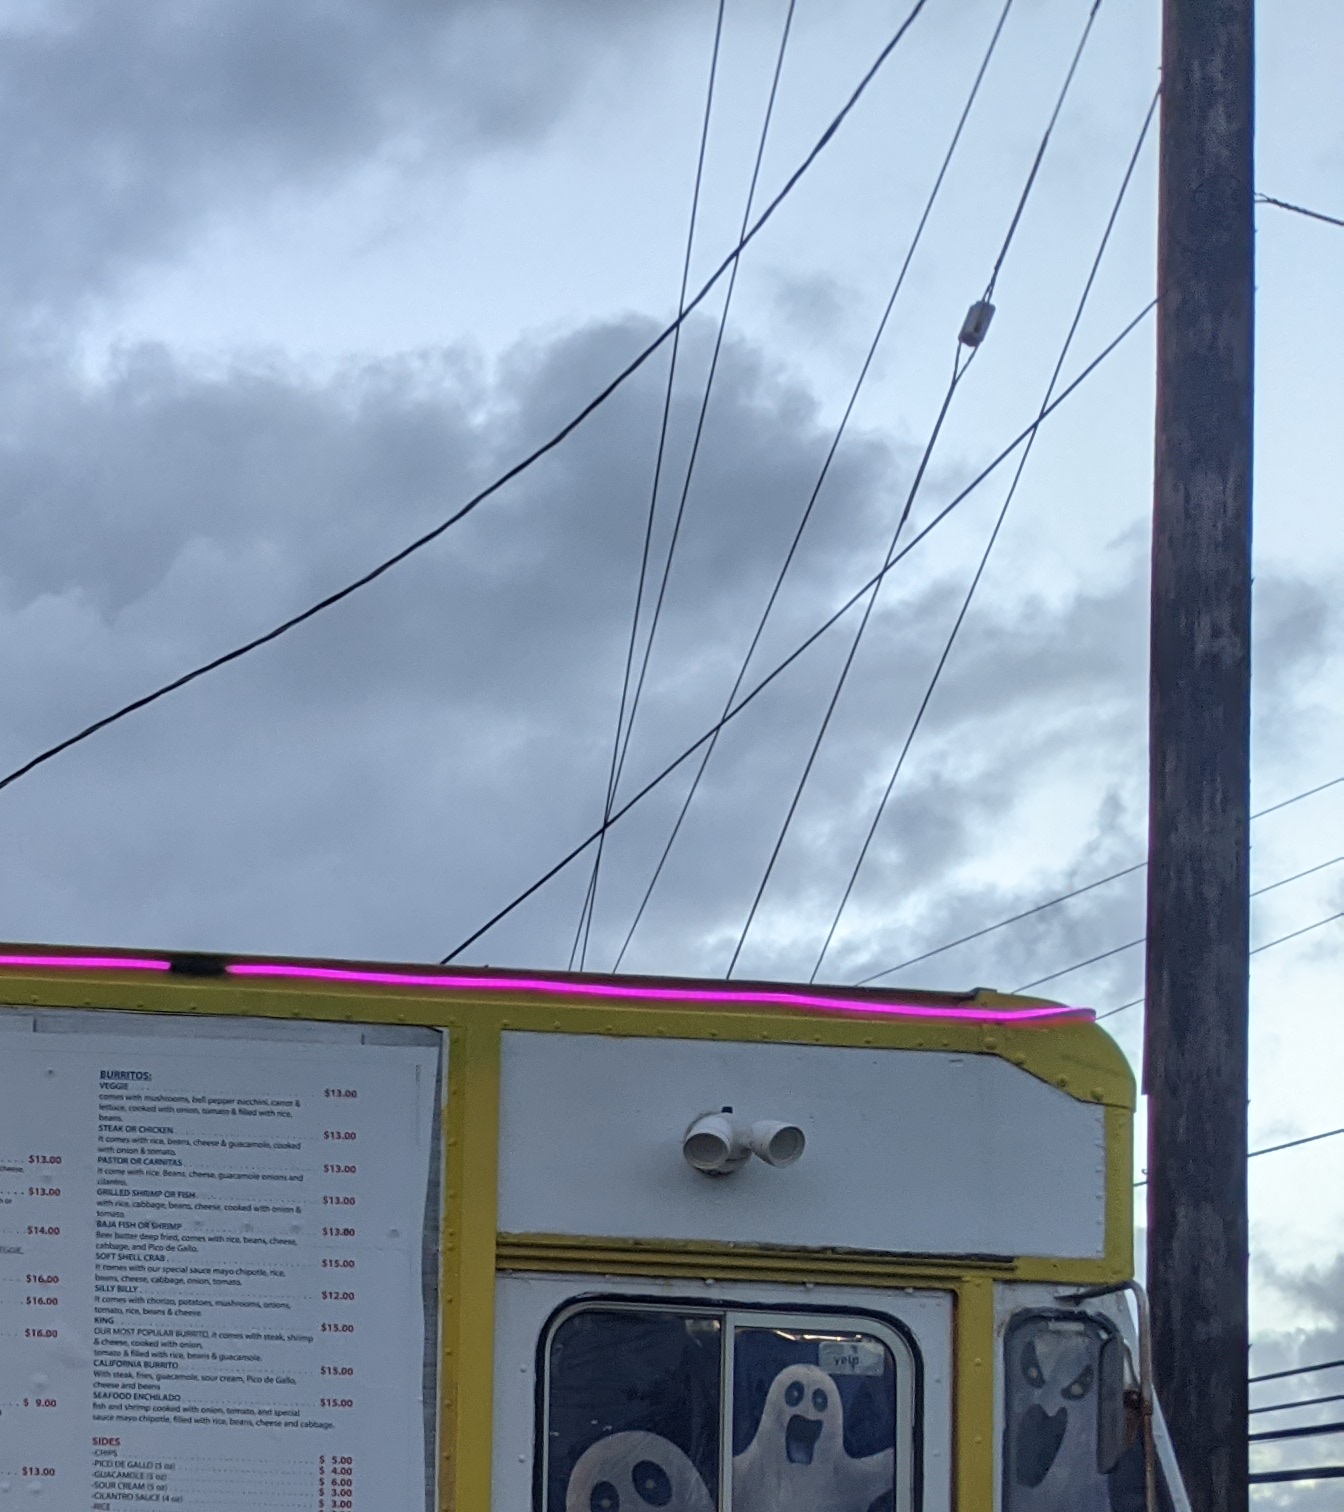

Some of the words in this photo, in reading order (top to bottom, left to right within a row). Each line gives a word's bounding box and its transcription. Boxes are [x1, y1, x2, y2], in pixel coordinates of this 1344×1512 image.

[100, 1070, 152, 1081] BURRITOS:
[324, 1089, 357, 1098] $13.00
[324, 1131, 356, 1140] $13.00
[28, 1155, 62, 1165] $13.00
[323, 1164, 356, 1174] $13.00
[28, 1188, 61, 1197] $13.00
[322, 1197, 356, 1206] $13.00
[27, 1226, 60, 1236] $14.00
[26, 1274, 59, 1284] $16.00
[322, 1292, 355, 1300] $12.00
[26, 1296, 58, 1306] $16.00
[24, 1329, 58, 1338] $16.00
[833, 1354, 859, 1369] yelp
[320, 1367, 354, 1376] $15.00
[35, 1398, 57, 1408] 9.00
[320, 1399, 353, 1408] $15.00
[92, 1437, 120, 1446] SIDES
[22, 1467, 55, 1476] $13.00
